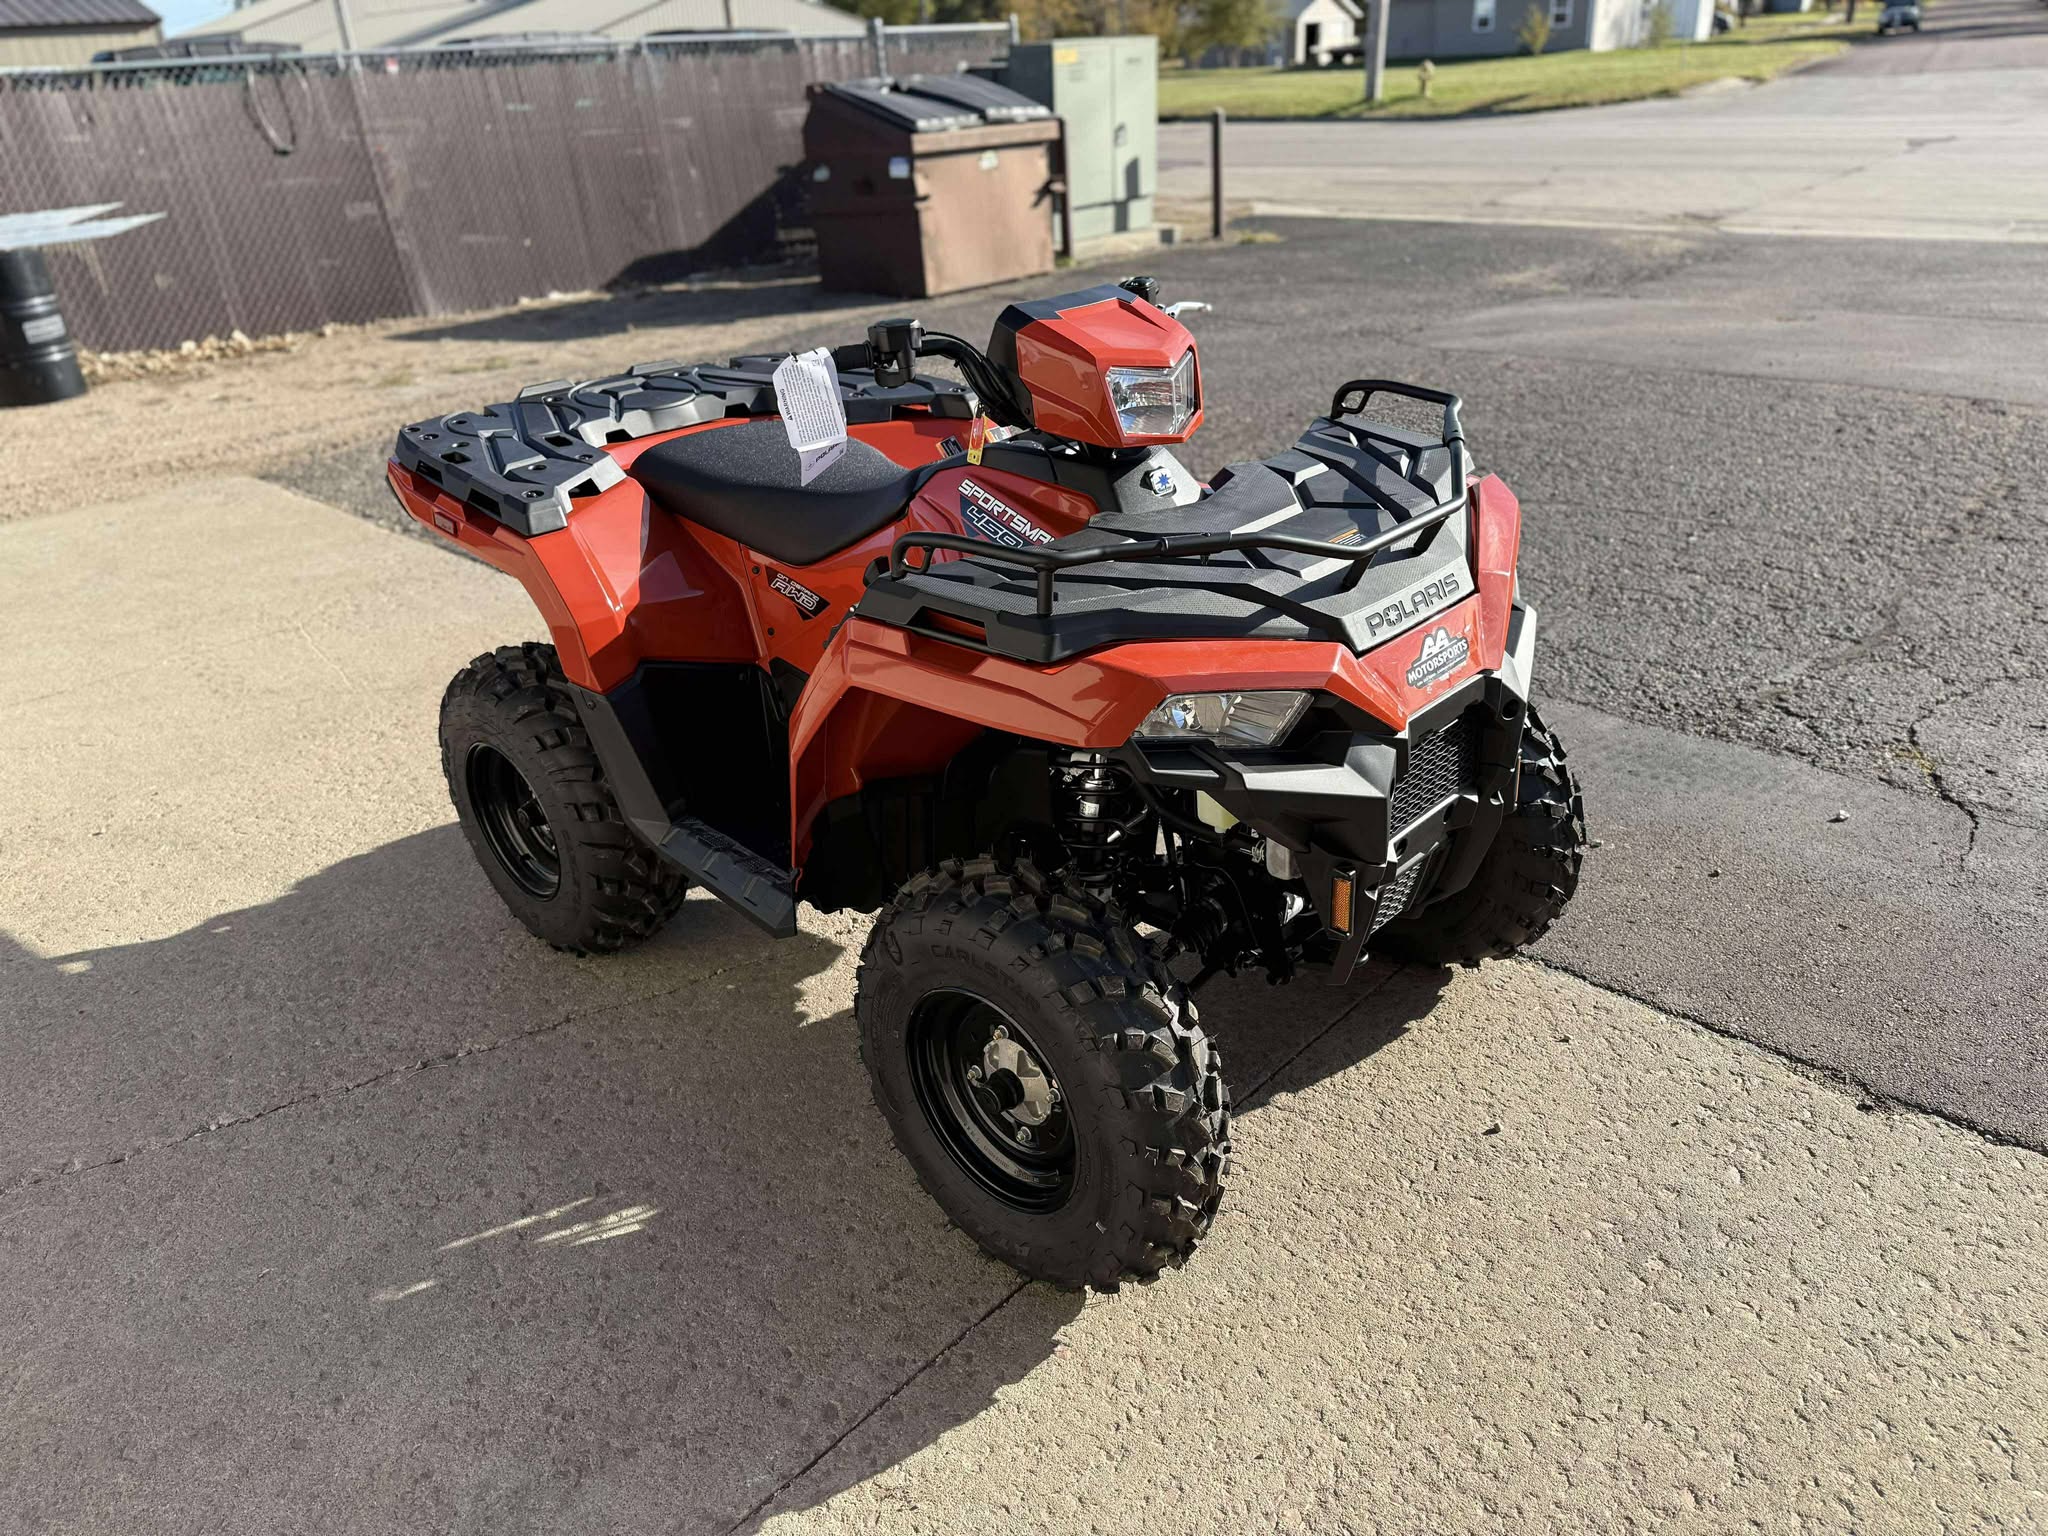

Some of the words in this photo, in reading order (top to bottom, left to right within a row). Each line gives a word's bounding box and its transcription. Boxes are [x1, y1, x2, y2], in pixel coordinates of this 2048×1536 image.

[780, 388, 793, 416] WARNING
[958, 478, 1056, 544] SPORTSMA
[770, 577, 817, 611] AWD
[1365, 572, 1460, 637] POLARIS
[1407, 639, 1468, 684] MOTORSPORTS
